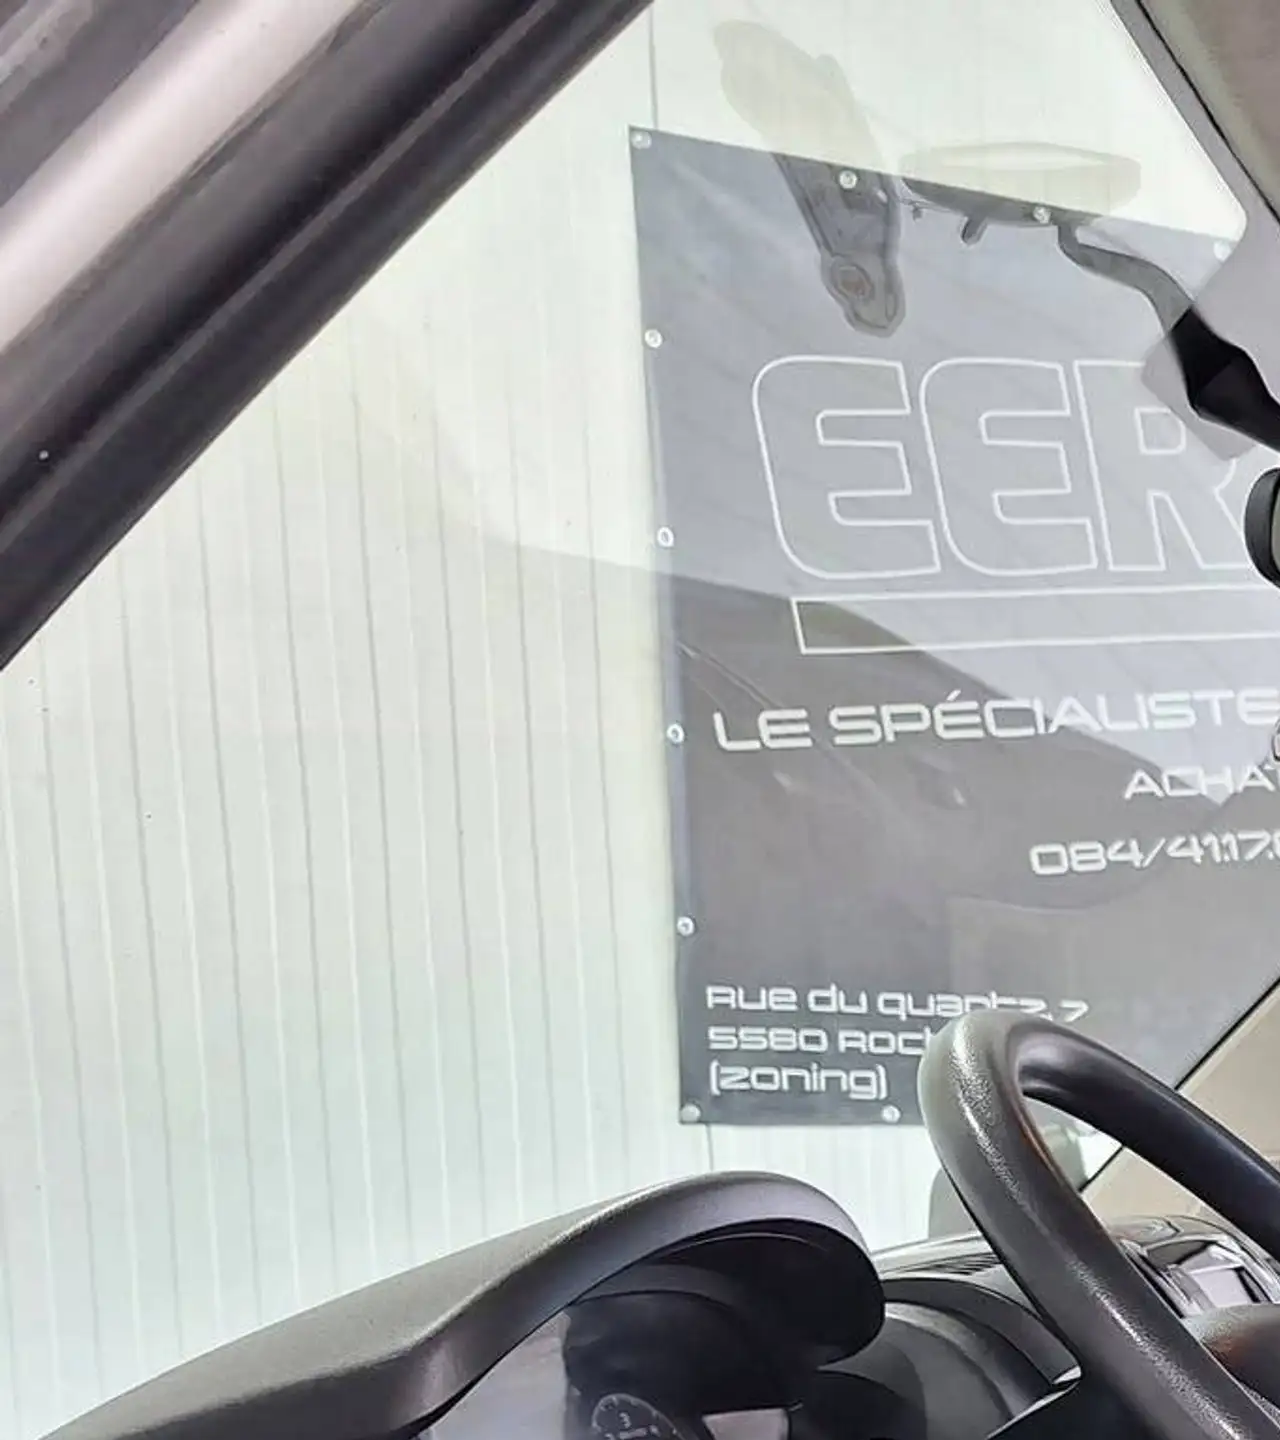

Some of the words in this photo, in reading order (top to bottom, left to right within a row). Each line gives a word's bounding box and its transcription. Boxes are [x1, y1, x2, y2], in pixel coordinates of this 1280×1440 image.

[713, 708, 813, 751] LE
[829, 688, 1280, 746] SPÉCIALISTE
[807, 983, 868, 1014] du
[708, 1026, 828, 1052] 5580
[710, 1059, 888, 1100] (zoning)
